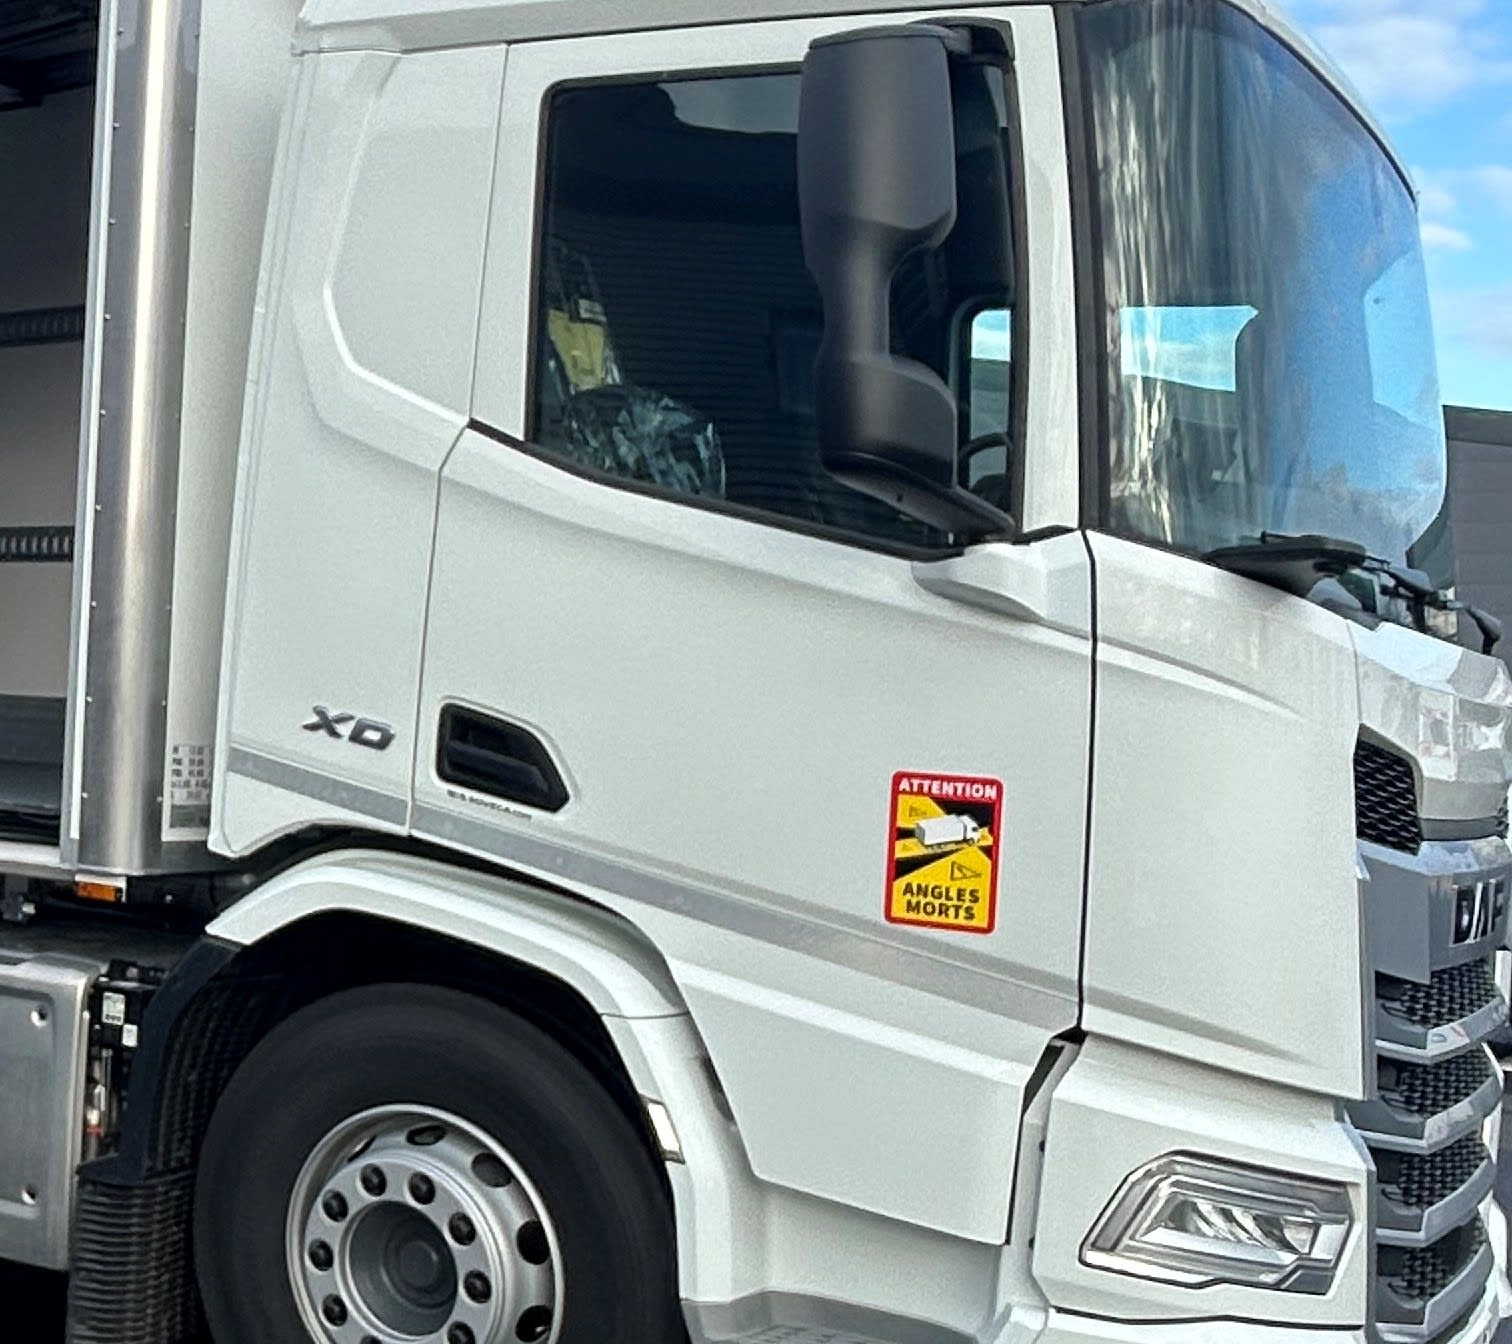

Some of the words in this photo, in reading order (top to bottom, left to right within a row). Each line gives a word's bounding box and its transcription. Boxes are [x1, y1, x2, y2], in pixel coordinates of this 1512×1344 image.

[301, 704, 397, 751] XD
[898, 777, 997, 800] ATTENTION
[902, 882, 980, 904] ANGLES
[905, 898, 976, 921] MORTS
